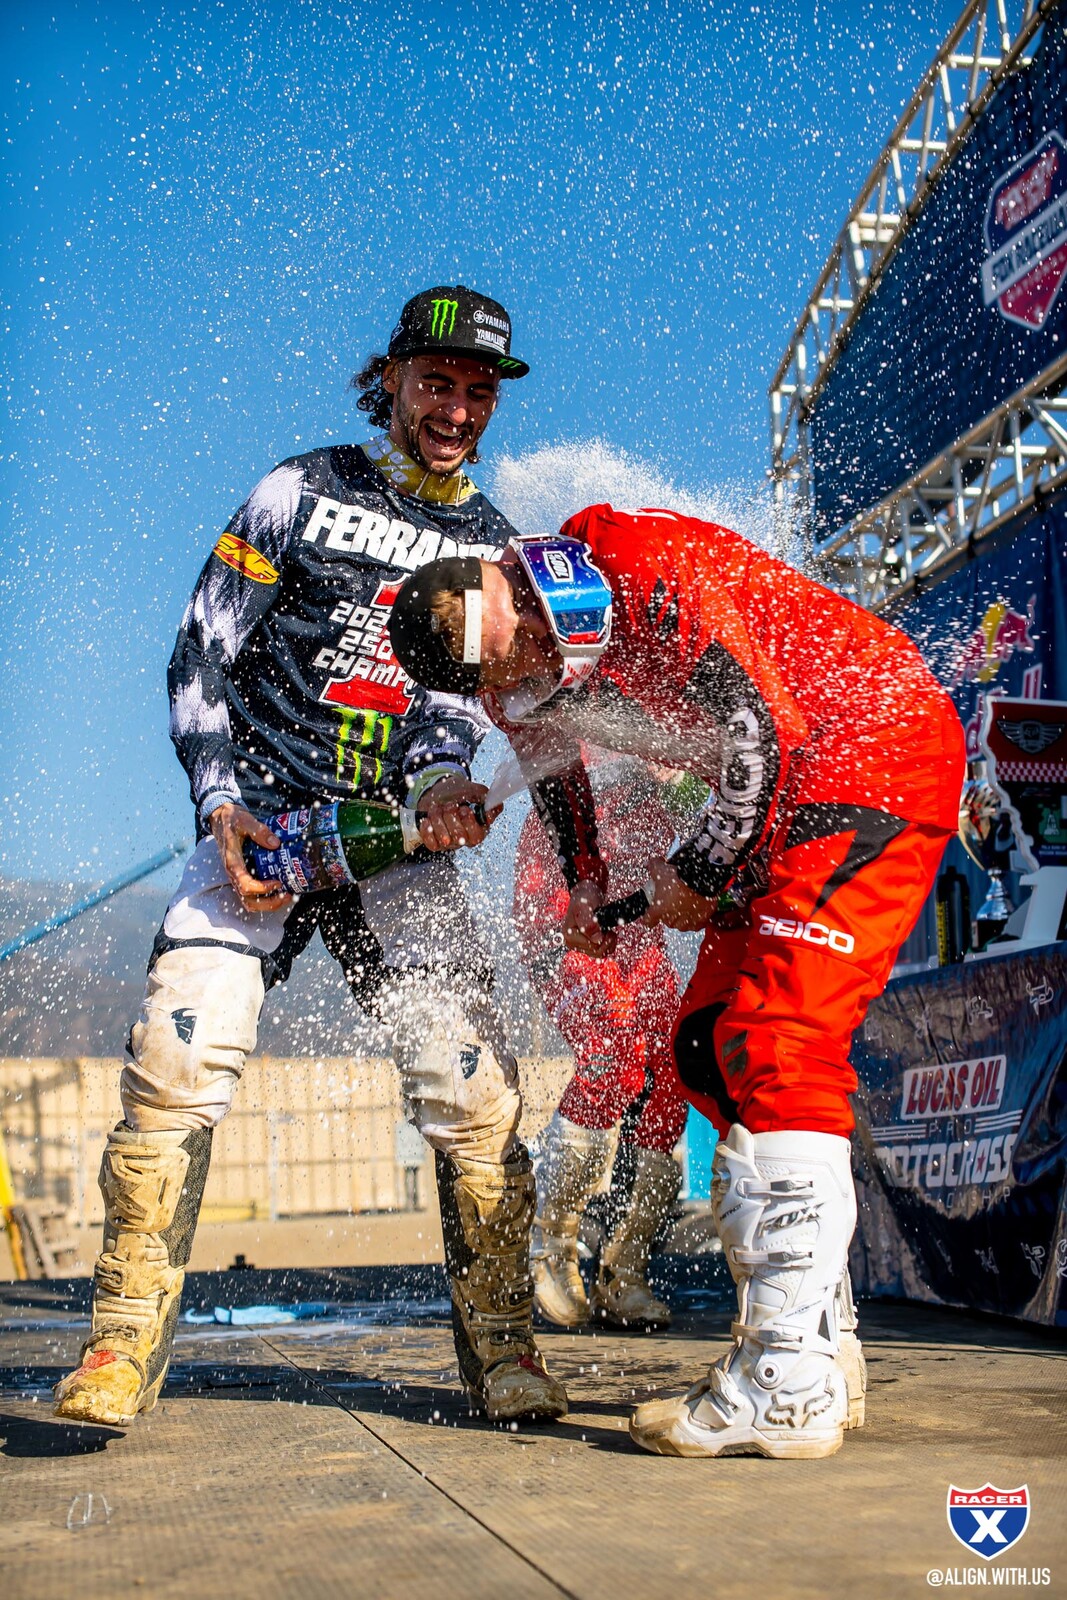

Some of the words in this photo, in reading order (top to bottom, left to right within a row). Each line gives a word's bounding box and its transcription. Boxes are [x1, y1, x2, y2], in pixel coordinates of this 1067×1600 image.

[476, 328, 507, 349] YAMALUBE
[485, 313, 510, 334] YAMAHA
[329, 600, 391, 636] 202
[337, 628, 394, 661] 250
[312, 647, 418, 690] CHAMP
[759, 915, 855, 954] GEICO
[905, 1063, 969, 1115] LUCAS
[971, 1059, 1002, 1108] OIL
[928, 1118, 972, 1138] PRO
[758, 1202, 825, 1240] FOX
